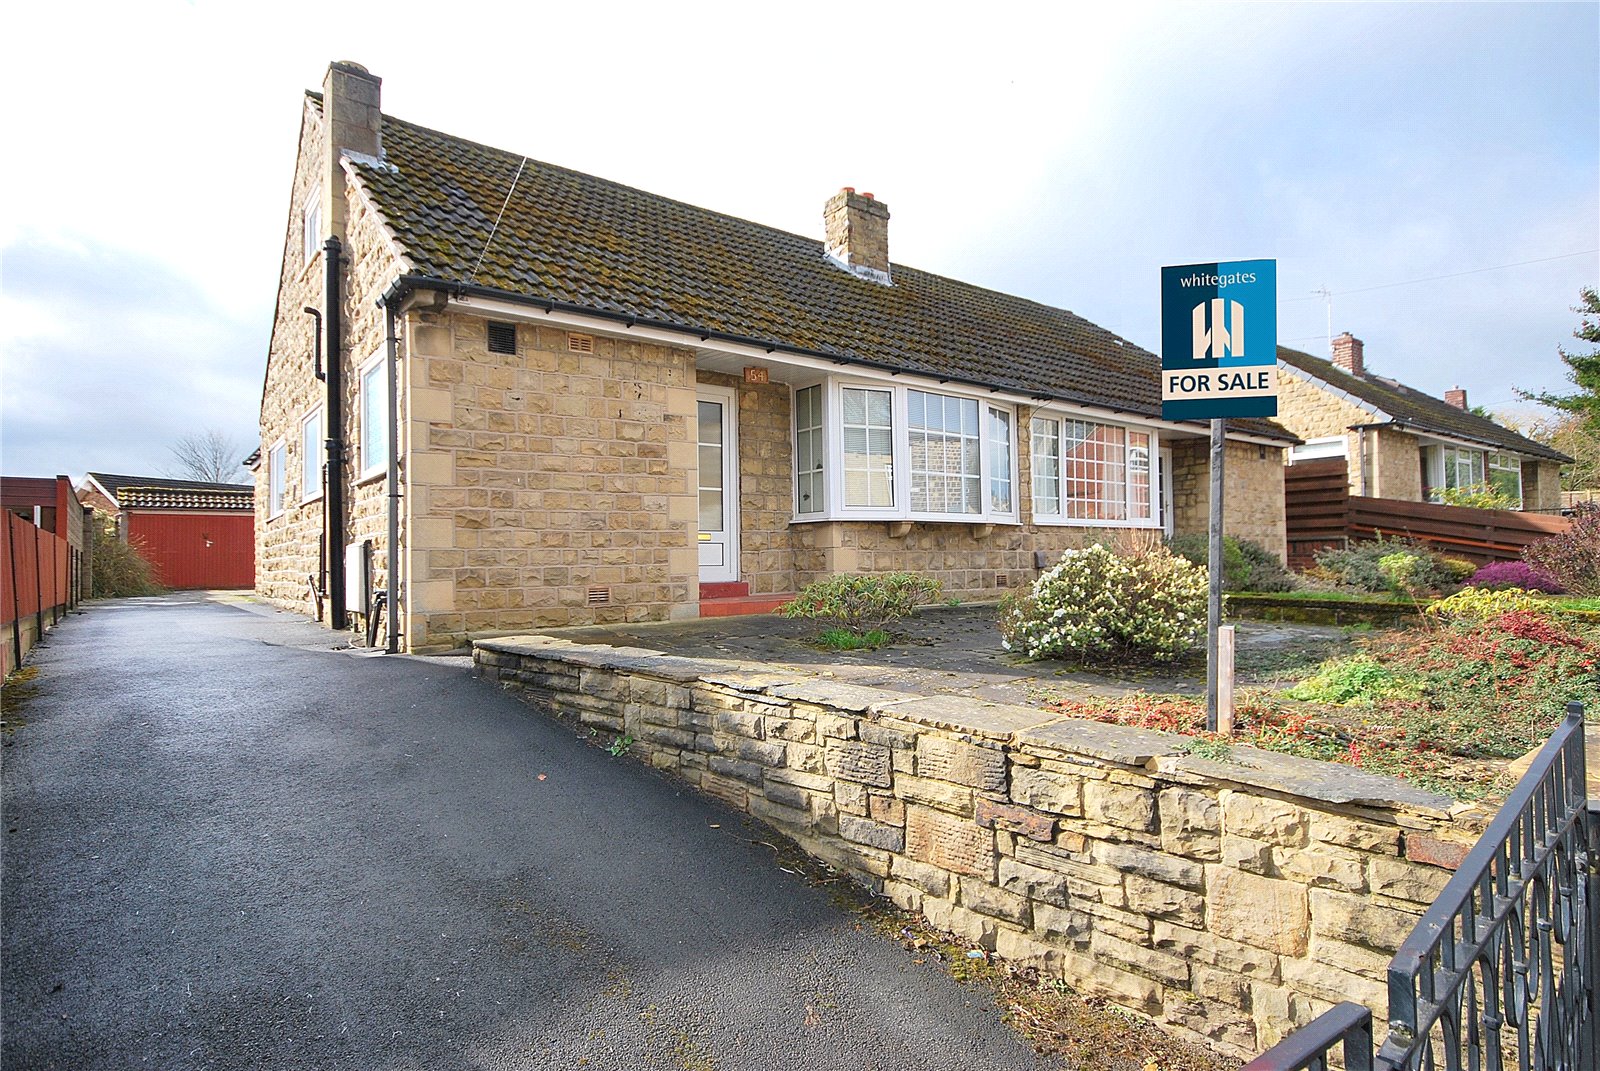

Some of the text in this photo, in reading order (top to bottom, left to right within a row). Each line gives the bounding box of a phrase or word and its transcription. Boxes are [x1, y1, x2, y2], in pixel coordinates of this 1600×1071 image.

[1180, 272, 1256, 288] whitegates
[750, 369, 765, 381] 54
[1169, 371, 1269, 393] FOR SALE
